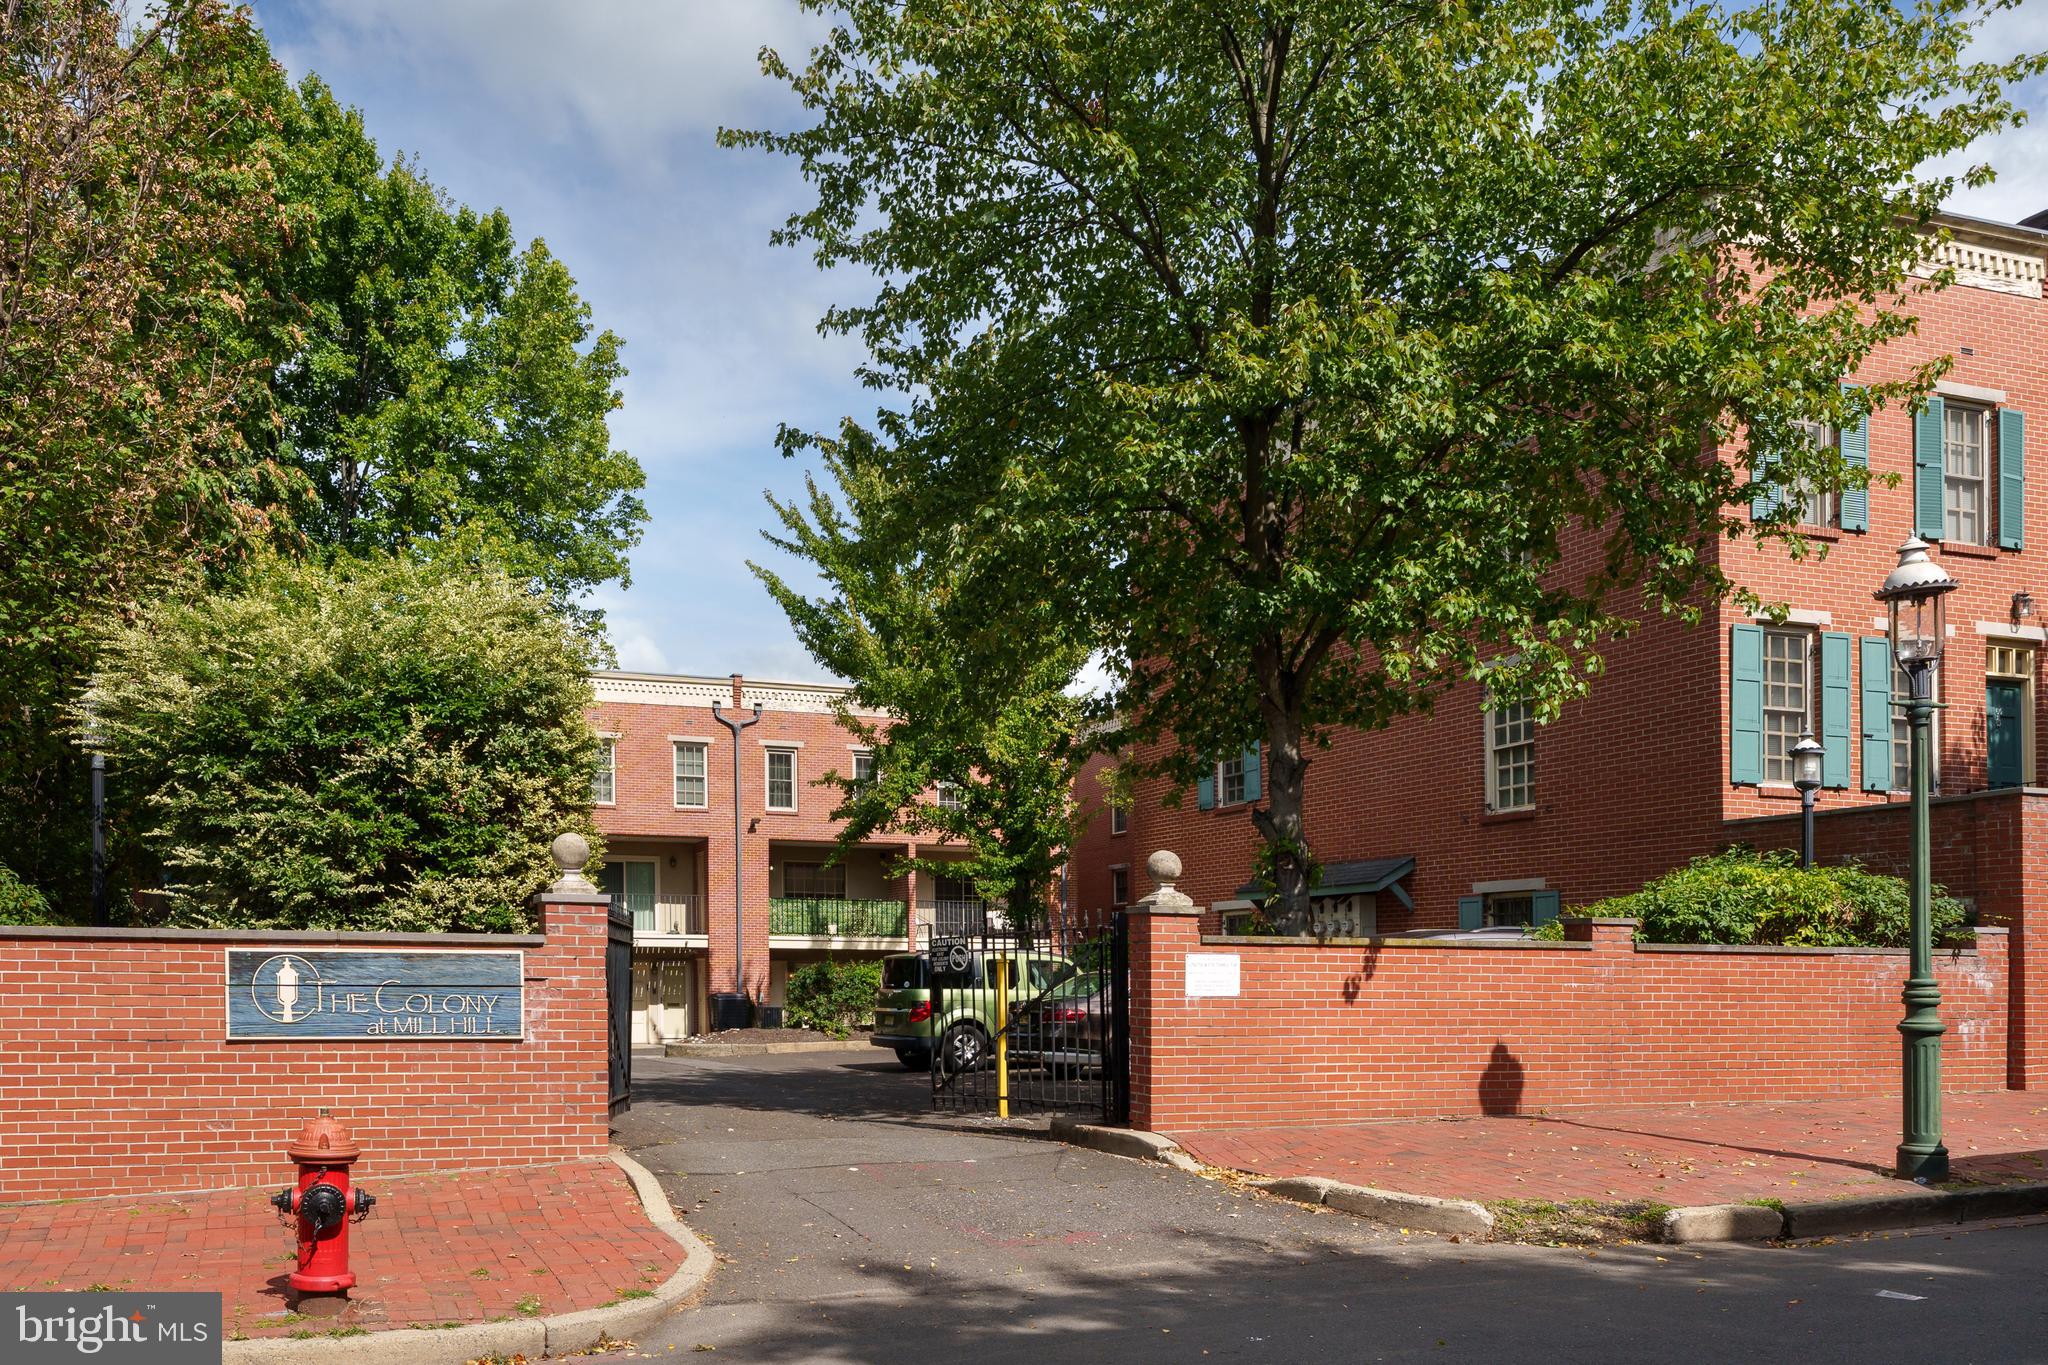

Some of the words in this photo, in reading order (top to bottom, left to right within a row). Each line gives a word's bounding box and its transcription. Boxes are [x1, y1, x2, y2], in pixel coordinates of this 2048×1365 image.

[931, 937, 966, 946] CAUTION
[304, 978, 370, 1013] THE
[376, 979, 498, 1014] COLONY
[367, 1018, 388, 1035] at
[394, 1016, 447, 1034] MILL
[450, 1016, 500, 1034] HILL
